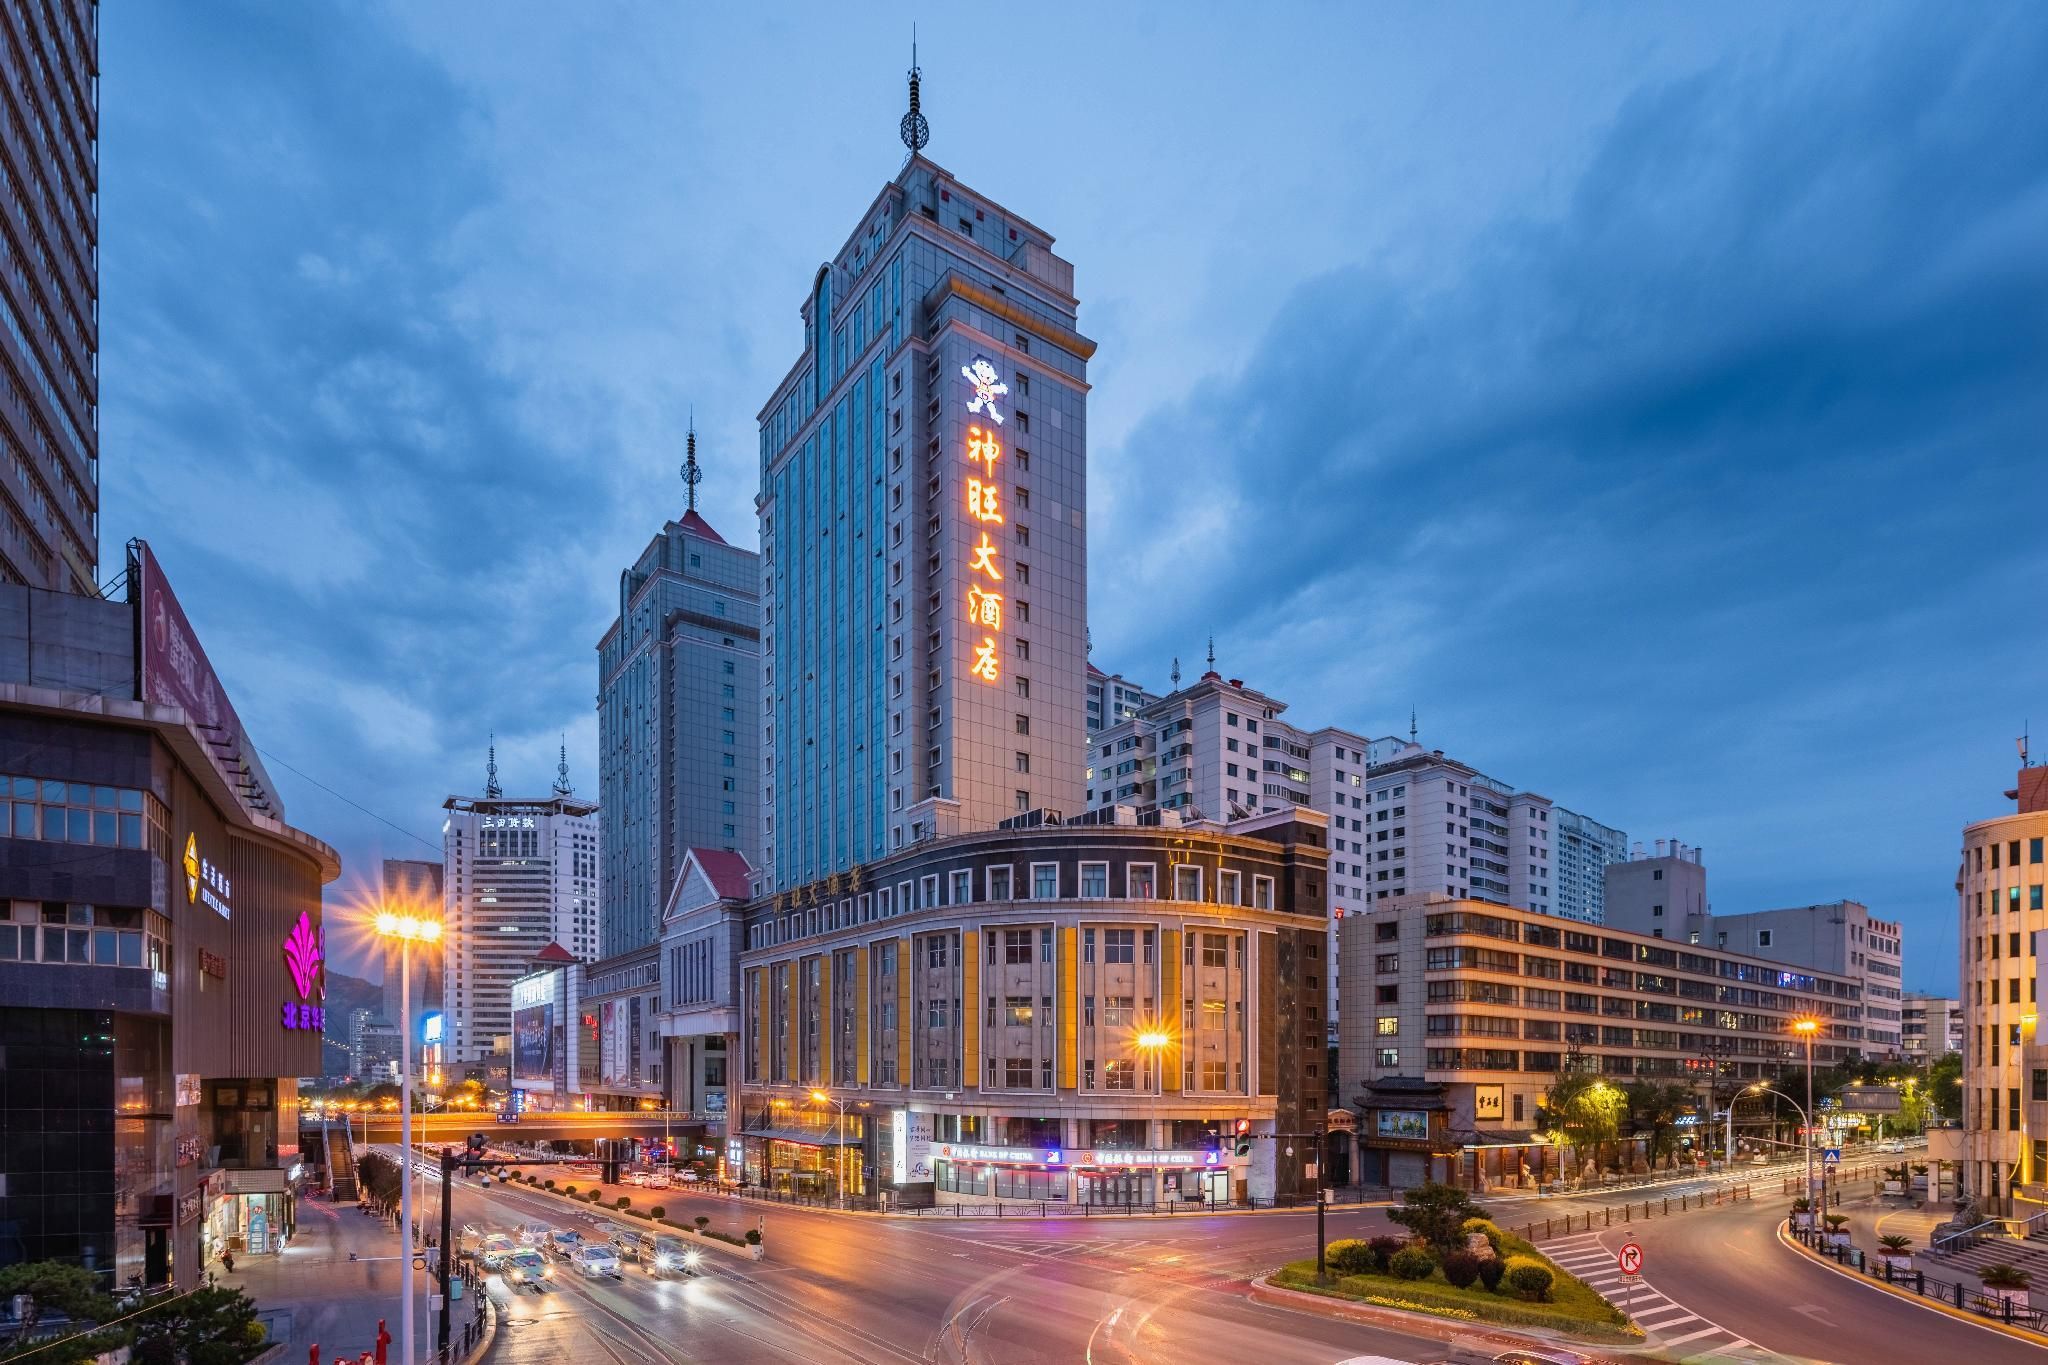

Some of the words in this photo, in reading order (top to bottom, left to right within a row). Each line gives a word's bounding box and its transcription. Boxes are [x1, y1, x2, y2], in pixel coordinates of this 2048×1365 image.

[967, 425, 1004, 682] 神旺大酒店
